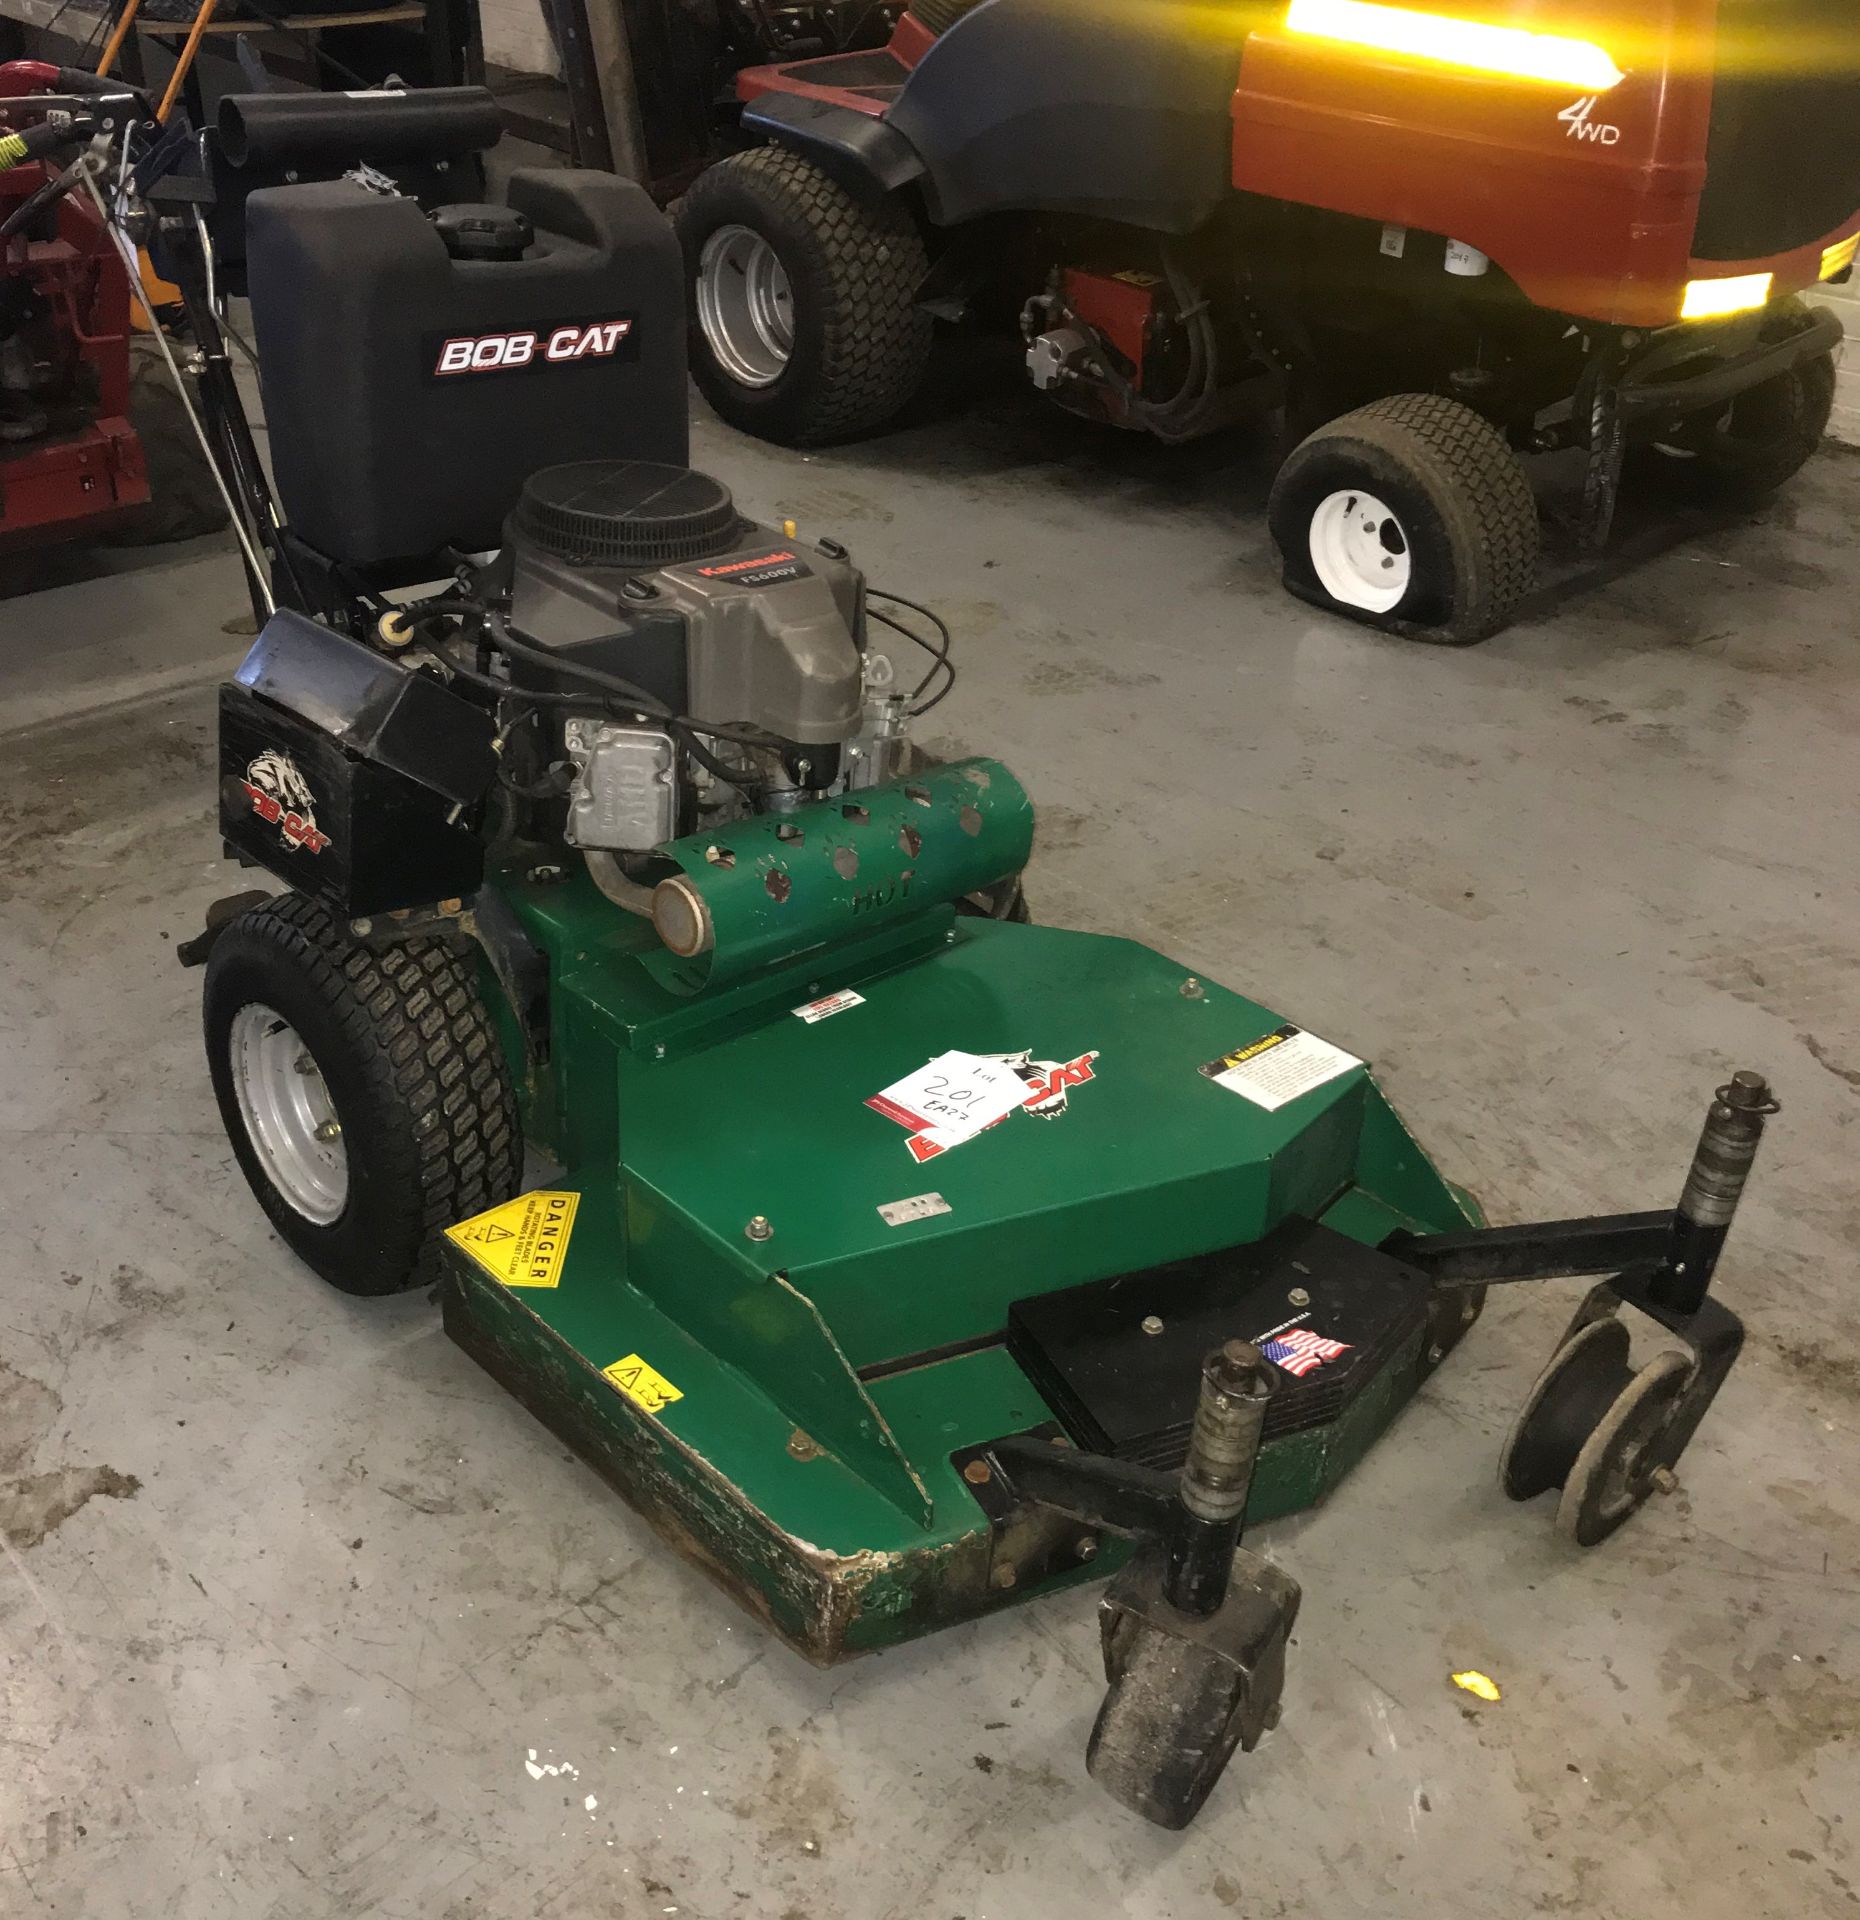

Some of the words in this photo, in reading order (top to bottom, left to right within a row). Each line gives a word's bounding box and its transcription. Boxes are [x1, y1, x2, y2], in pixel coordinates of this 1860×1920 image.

[1557, 95, 1620, 145] 4WD
[435, 320, 632, 375] BOB-CAT
[697, 551, 796, 576] Kawasaki
[741, 566, 798, 583] FS600V
[852, 870, 916, 915] HOT
[1234, 1034, 1284, 1060] WARNING
[972, 1067, 997, 1084] Lot
[924, 1075, 985, 1108] 201
[923, 1100, 969, 1121] EA27
[526, 1200, 536, 1214] KEEP
[520, 1215, 531, 1236] HANDS
[529, 1212, 542, 1240] ROTATING
[514, 1241, 524, 1255] FEET
[531, 1199, 566, 1278] DANGER
[521, 1240, 534, 1263] BLADES
[508, 1256, 520, 1275] CLEAR
